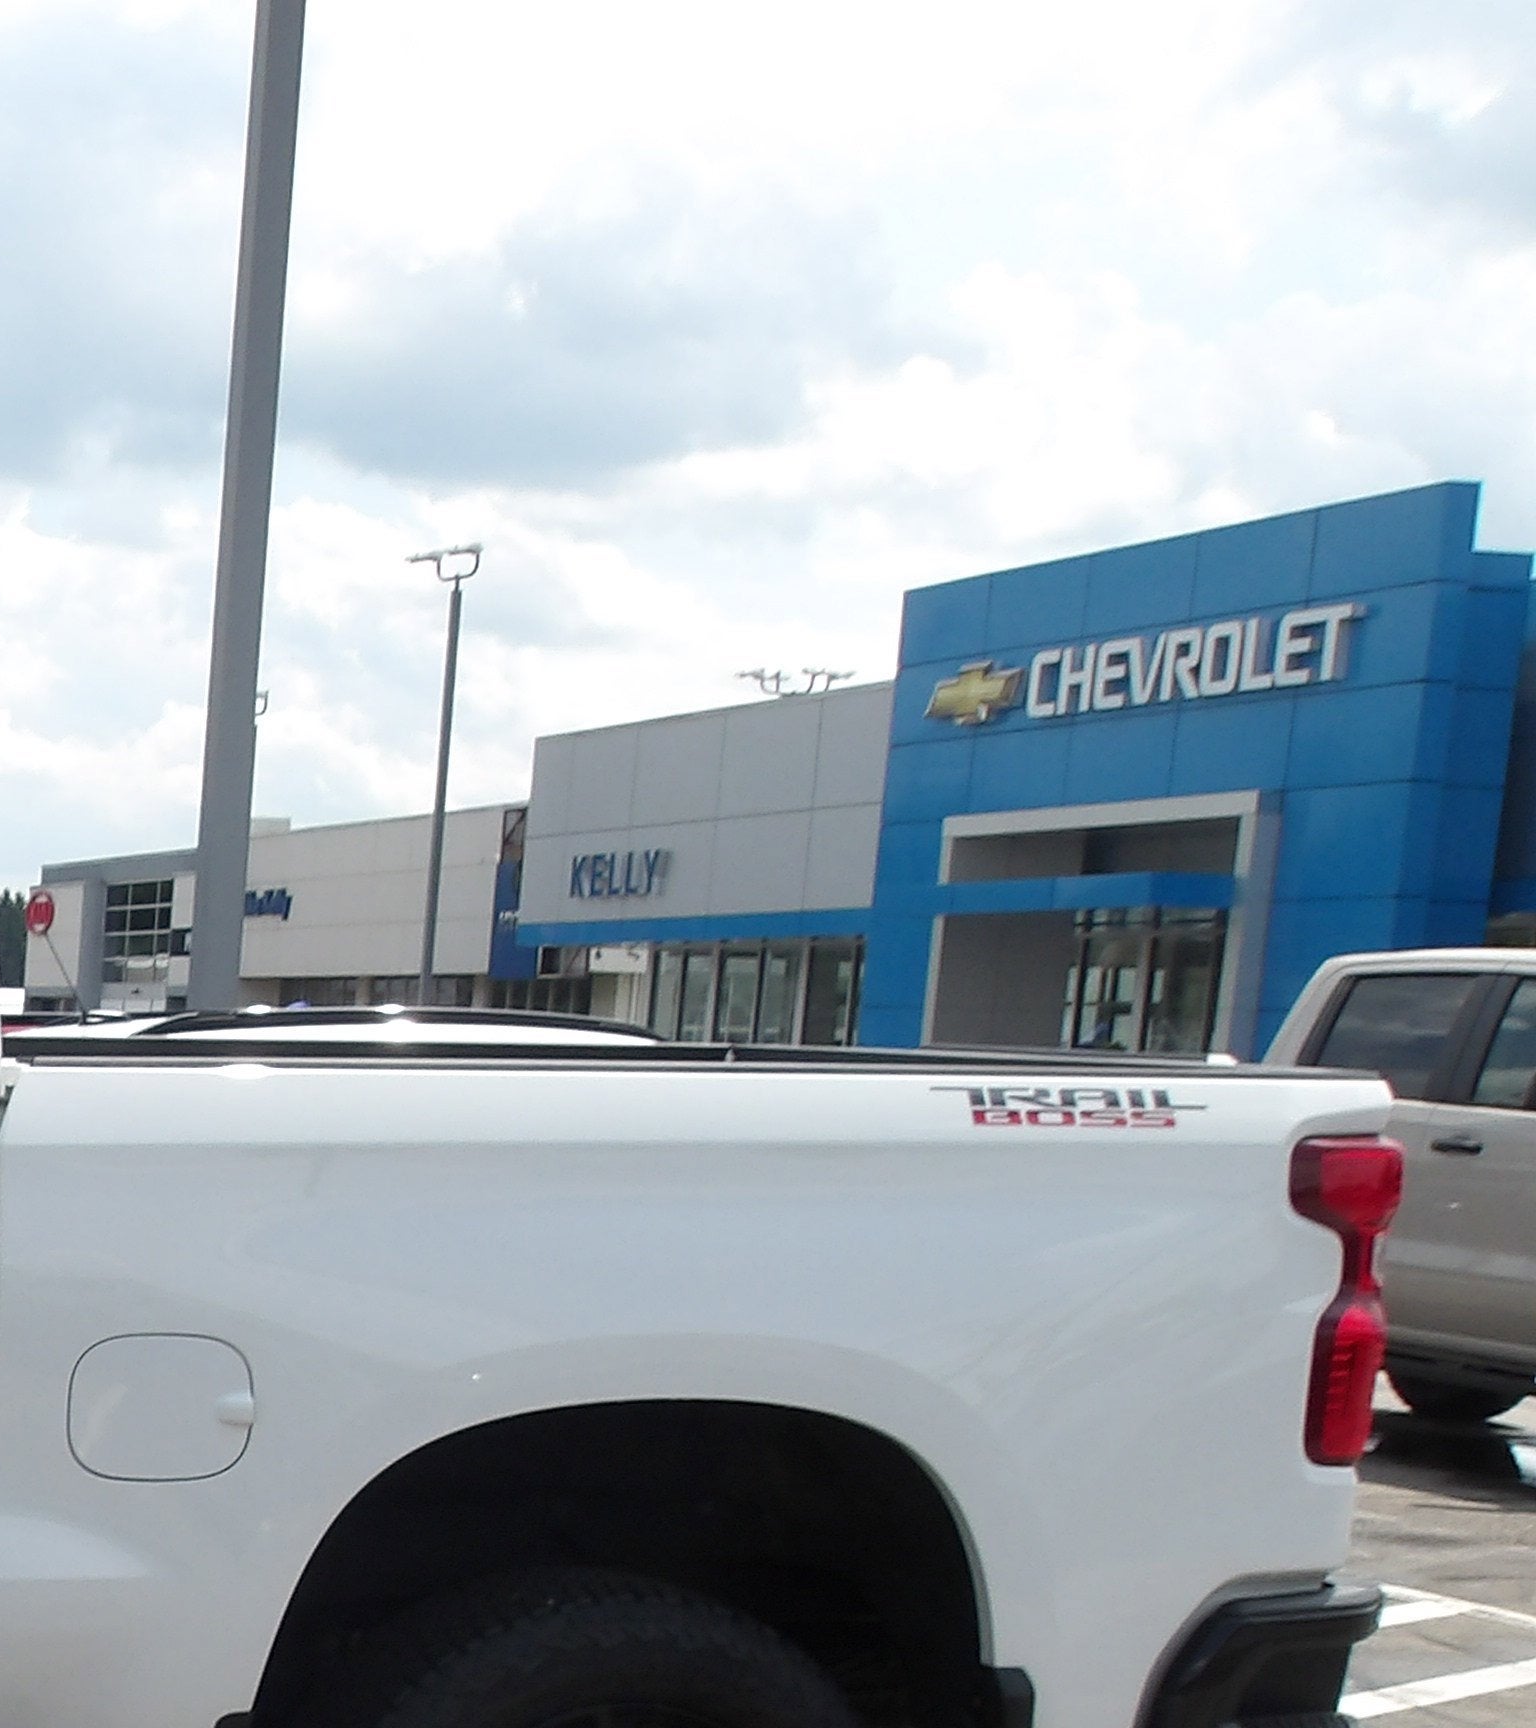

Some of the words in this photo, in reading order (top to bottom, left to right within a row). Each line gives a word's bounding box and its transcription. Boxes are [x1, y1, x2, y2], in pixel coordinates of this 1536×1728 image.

[1027, 602, 1366, 718] CHEVROLET
[569, 850, 661, 898] KELLY
[929, 1086, 1207, 1110] TRAIL
[973, 1109, 1176, 1127] BOSS
